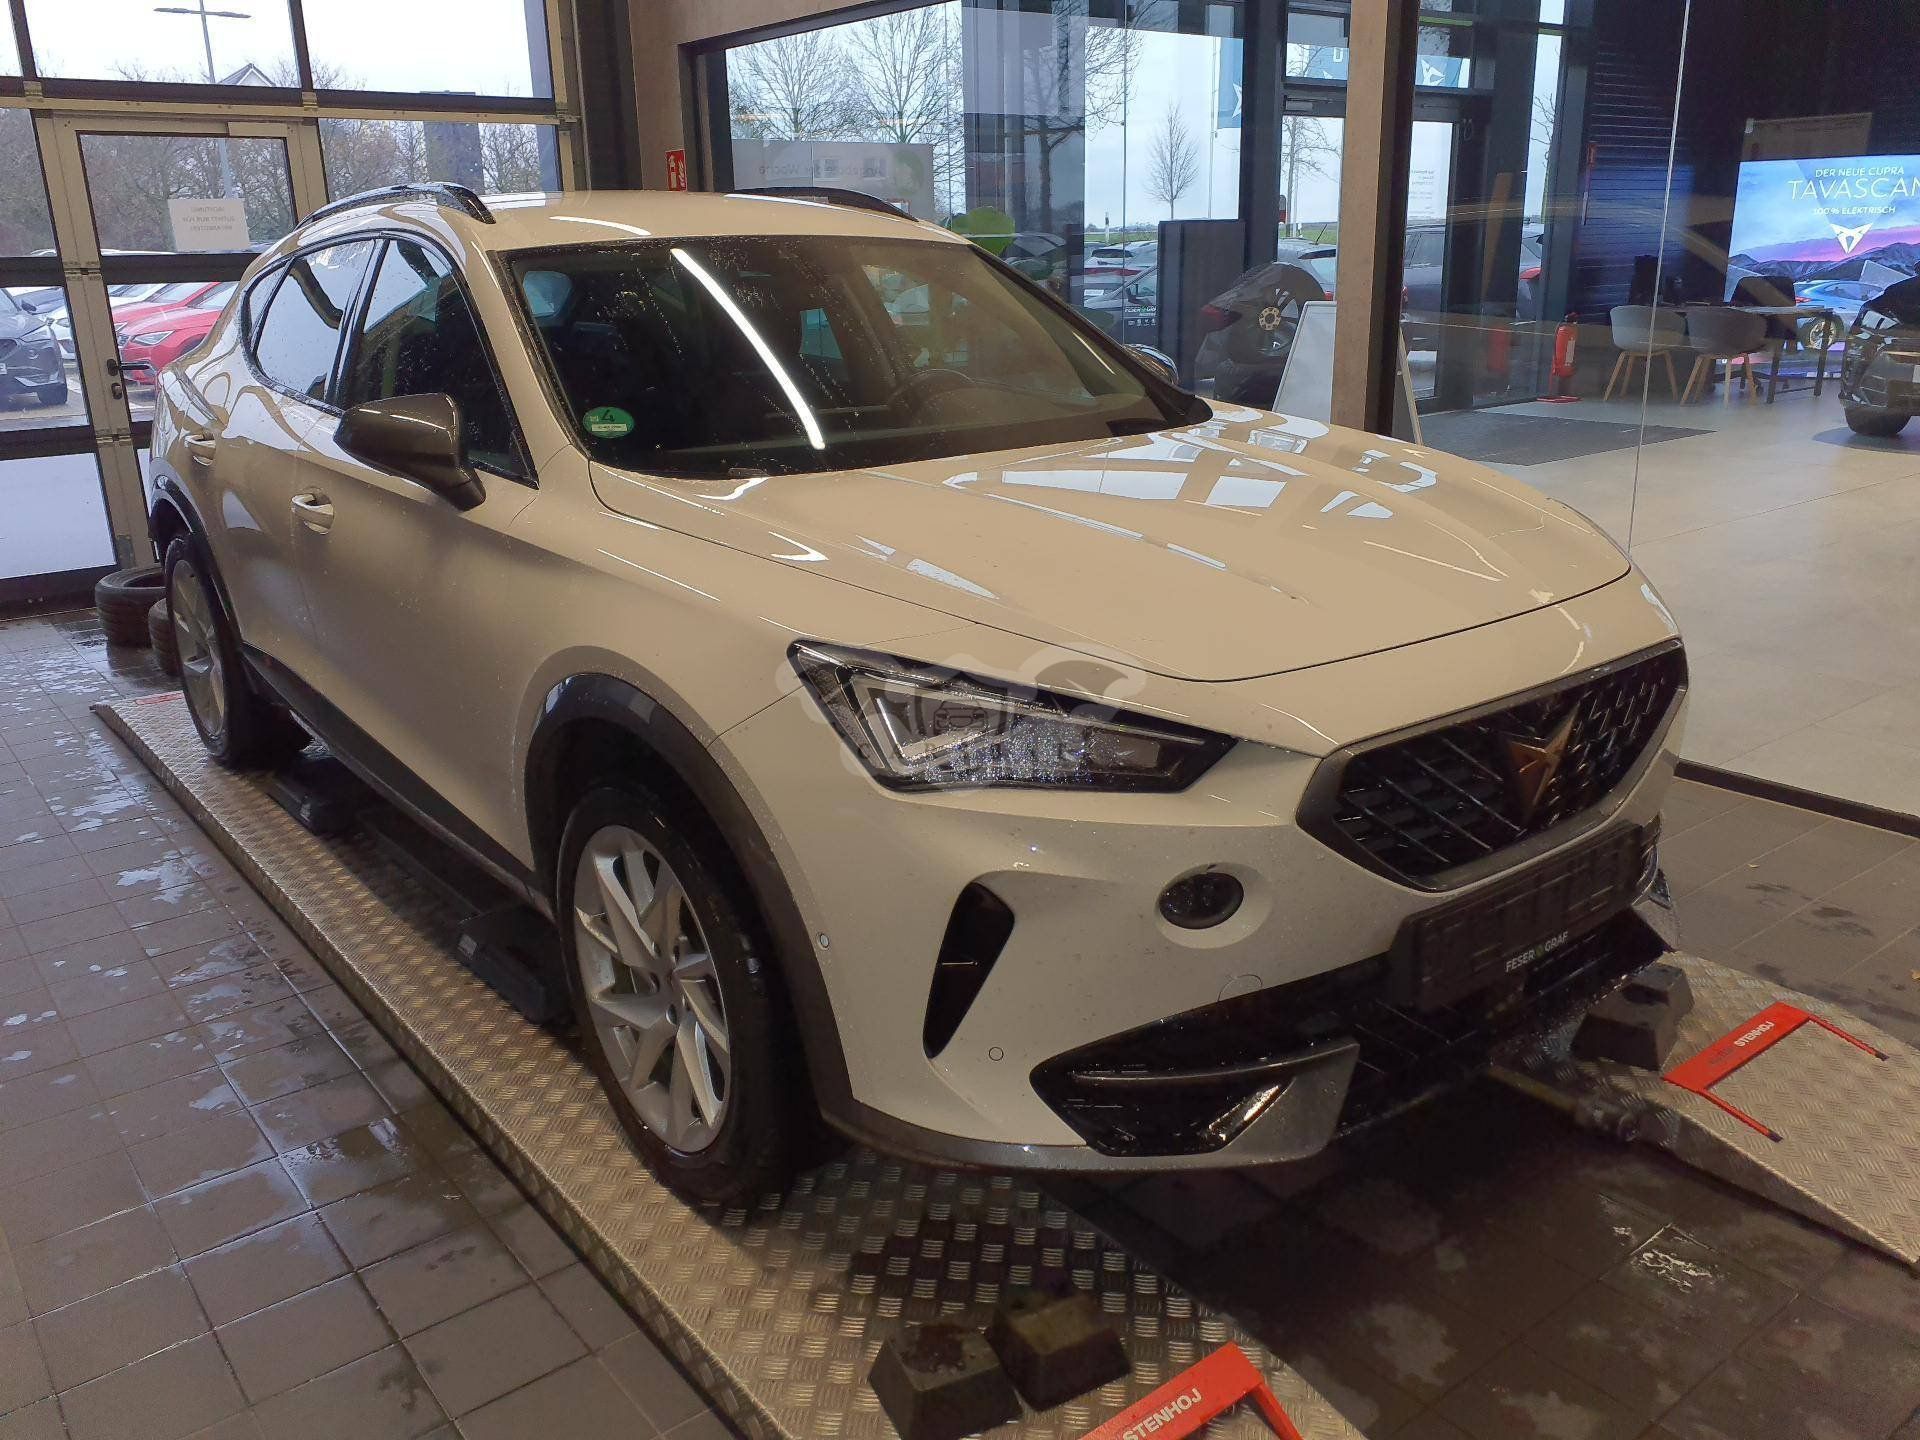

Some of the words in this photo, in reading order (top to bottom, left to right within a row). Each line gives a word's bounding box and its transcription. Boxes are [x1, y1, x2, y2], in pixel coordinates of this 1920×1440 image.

[1815, 168, 1836, 178] DER
[1838, 168, 1866, 177] NEUE
[1868, 166, 1905, 176] CUPRA
[1842, 206, 1896, 215] ELEKTRISCH
[601, 409, 616, 422] 4
[1505, 949, 1536, 973] FESER
[1544, 930, 1569, 952] GRAF
[1122, 1387, 1202, 1440] STENHOJ
